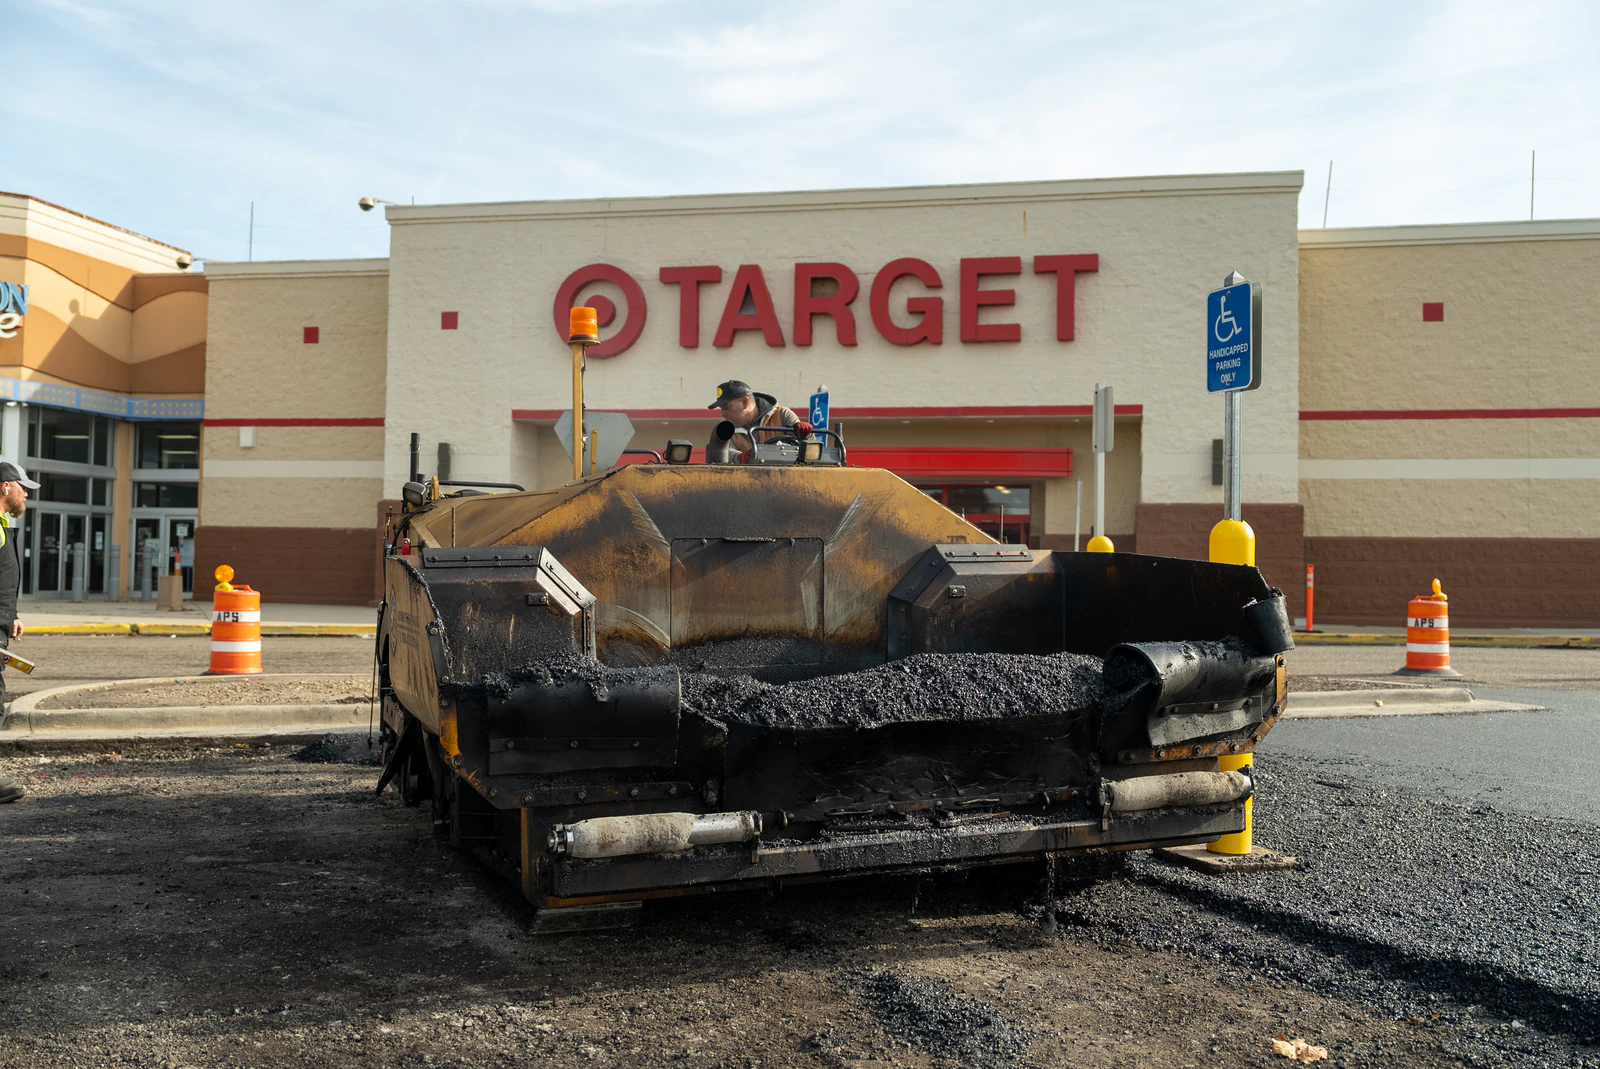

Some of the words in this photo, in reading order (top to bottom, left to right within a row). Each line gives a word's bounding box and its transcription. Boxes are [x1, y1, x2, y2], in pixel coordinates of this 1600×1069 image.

[659, 253, 1099, 348] TARGET
[1209, 343, 1249, 359] HANDICAPPED
[1216, 358, 1241, 371] PARKING
[1220, 372, 1236, 383] ONLY
[217, 611, 239, 622] APS
[1414, 618, 1435, 628] APS
